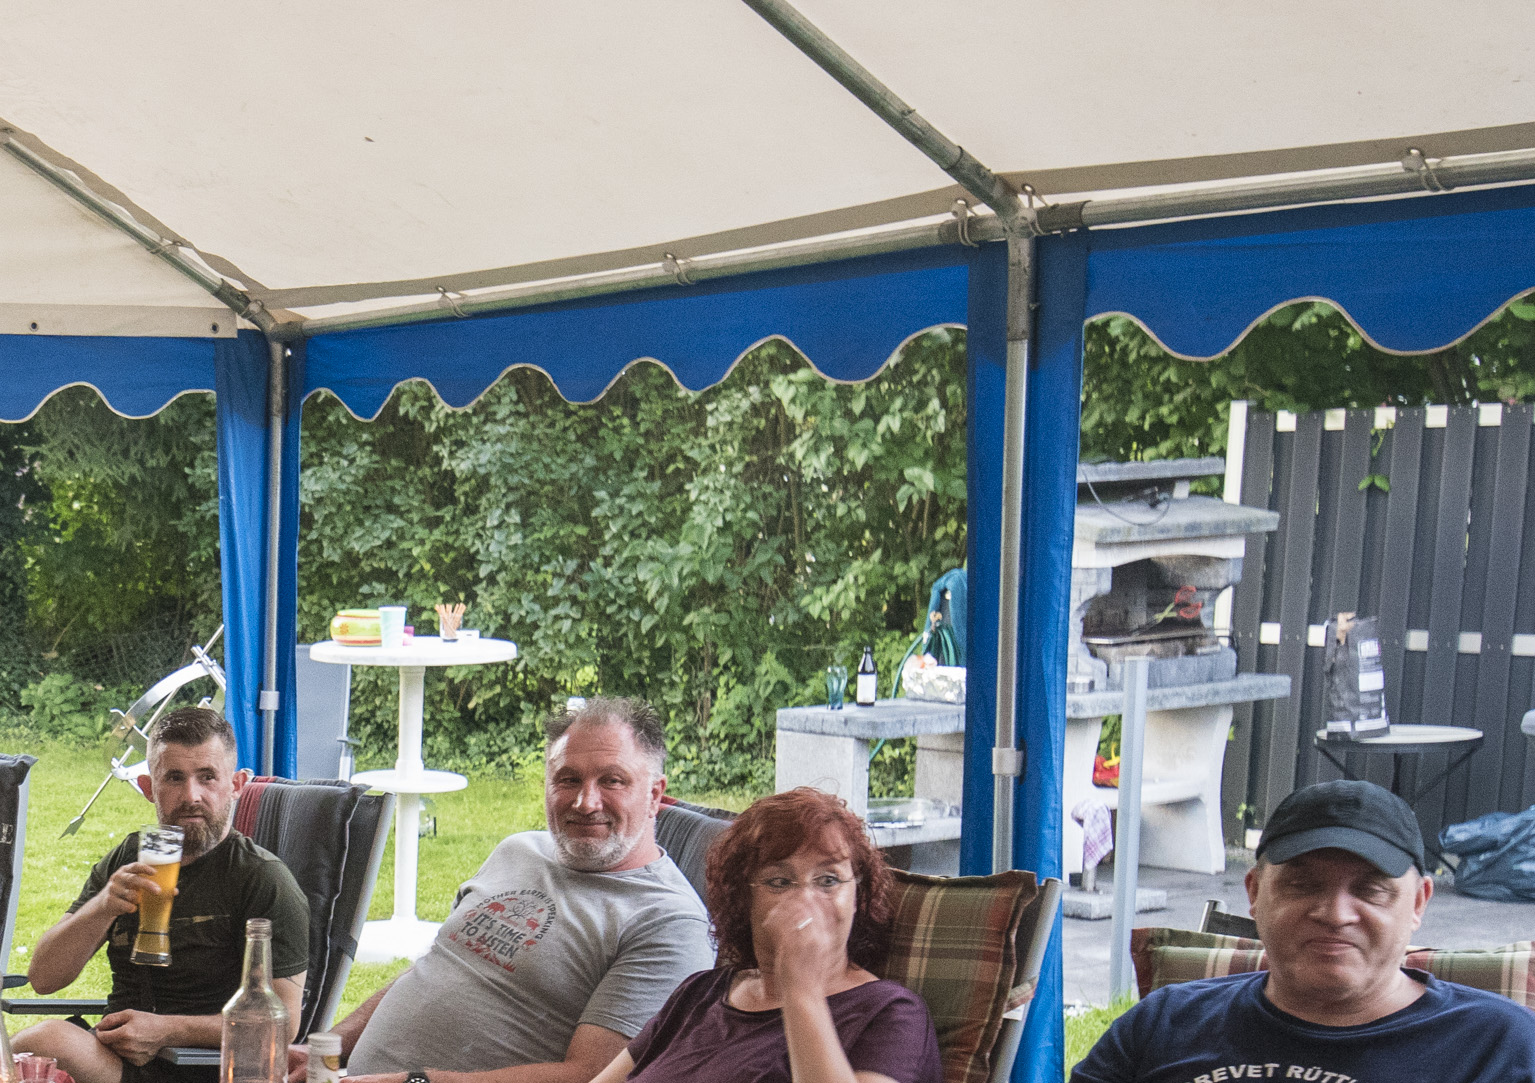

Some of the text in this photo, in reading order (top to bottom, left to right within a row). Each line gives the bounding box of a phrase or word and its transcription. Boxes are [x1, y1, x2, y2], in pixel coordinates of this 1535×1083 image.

[472, 912, 527, 944] IT'S TIME
[476, 889, 517, 909] MOTHER
[520, 890, 547, 900] EARTH
[534, 903, 557, 940] SPEAKING
[460, 921, 519, 958] TO LISTEN
